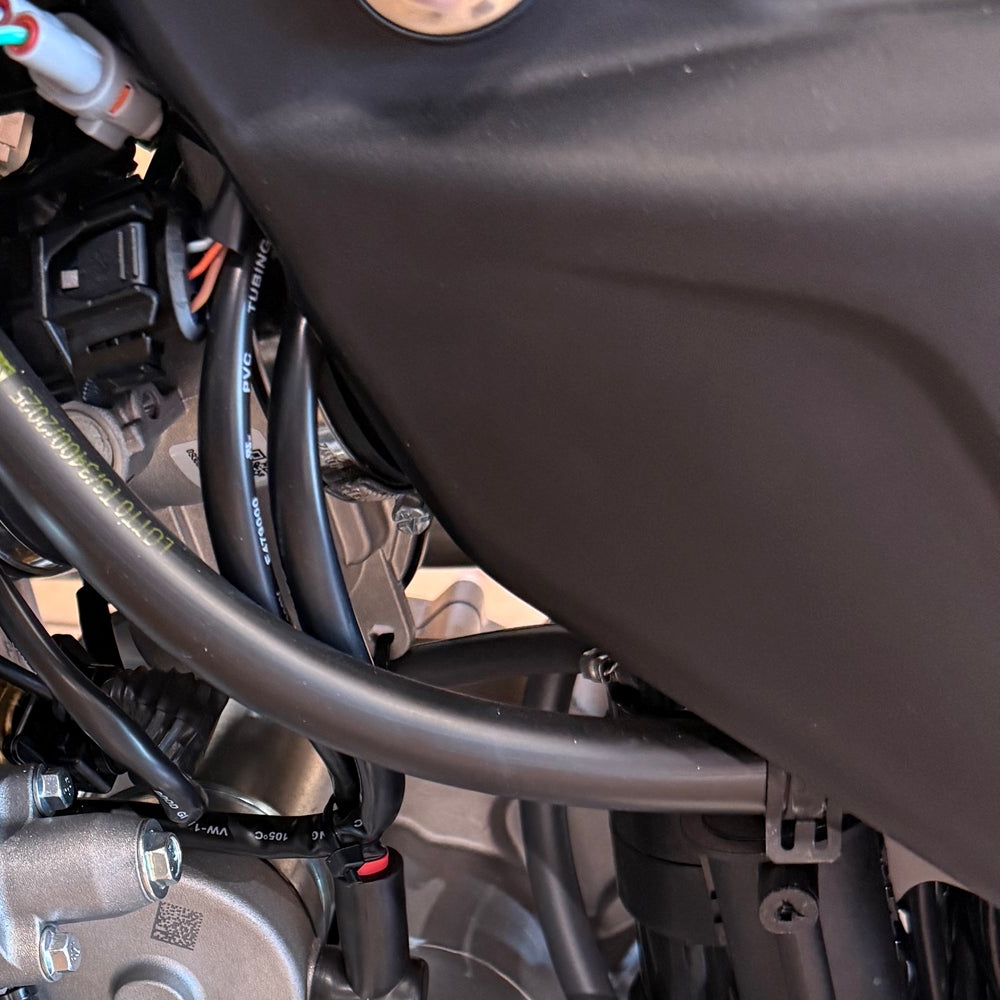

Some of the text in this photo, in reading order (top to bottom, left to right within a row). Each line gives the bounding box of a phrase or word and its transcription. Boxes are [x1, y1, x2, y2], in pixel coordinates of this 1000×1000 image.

[247, 238, 273, 315] TUBING
[242, 352, 253, 394] PVC
[114, 499, 175, 553] LOTTO
[193, 823, 229, 837] VW-1
